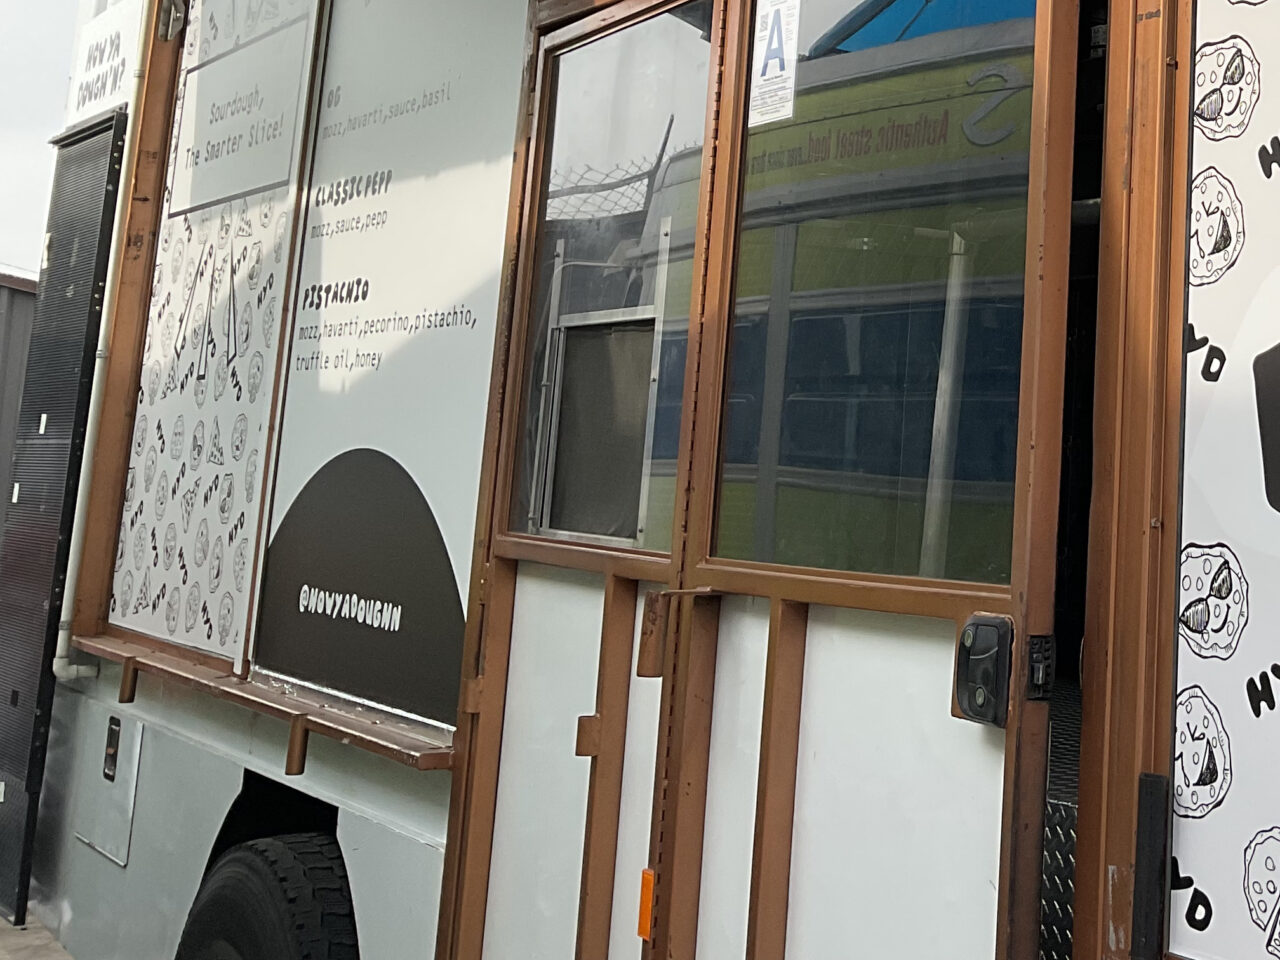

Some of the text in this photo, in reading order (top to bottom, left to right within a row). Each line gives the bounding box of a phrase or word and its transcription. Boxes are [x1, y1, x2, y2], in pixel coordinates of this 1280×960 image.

[85, 30, 120, 73] HOW YA
[760, 8, 786, 78] A
[209, 83, 264, 125] Sourdough,
[326, 85, 341, 109] OG
[185, 111, 284, 170] The Smarter Slice!
[315, 169, 393, 207] CLASSIC PEPP
[311, 210, 388, 239] mozz,sauce,pepp
[157, 292, 171, 323] HYD
[257, 272, 274, 310] HYD
[302, 277, 369, 311] PISTACHIO
[180, 361, 195, 395] HYD
[296, 348, 383, 371] truffle oil,honey
[230, 365, 242, 402] HYD
[156, 418, 165, 454] HYD
[172, 461, 186, 500] HYD
[203, 474, 219, 507] HYD
[130, 500, 144, 531] HYD
[228, 511, 245, 546] HYD
[151, 526, 159, 567] HYD
[178, 546, 188, 585] HYD
[151, 583, 167, 615] HYD
[299, 584, 401, 632] @HOWYADOUGHN
[201, 600, 213, 640] HYD
